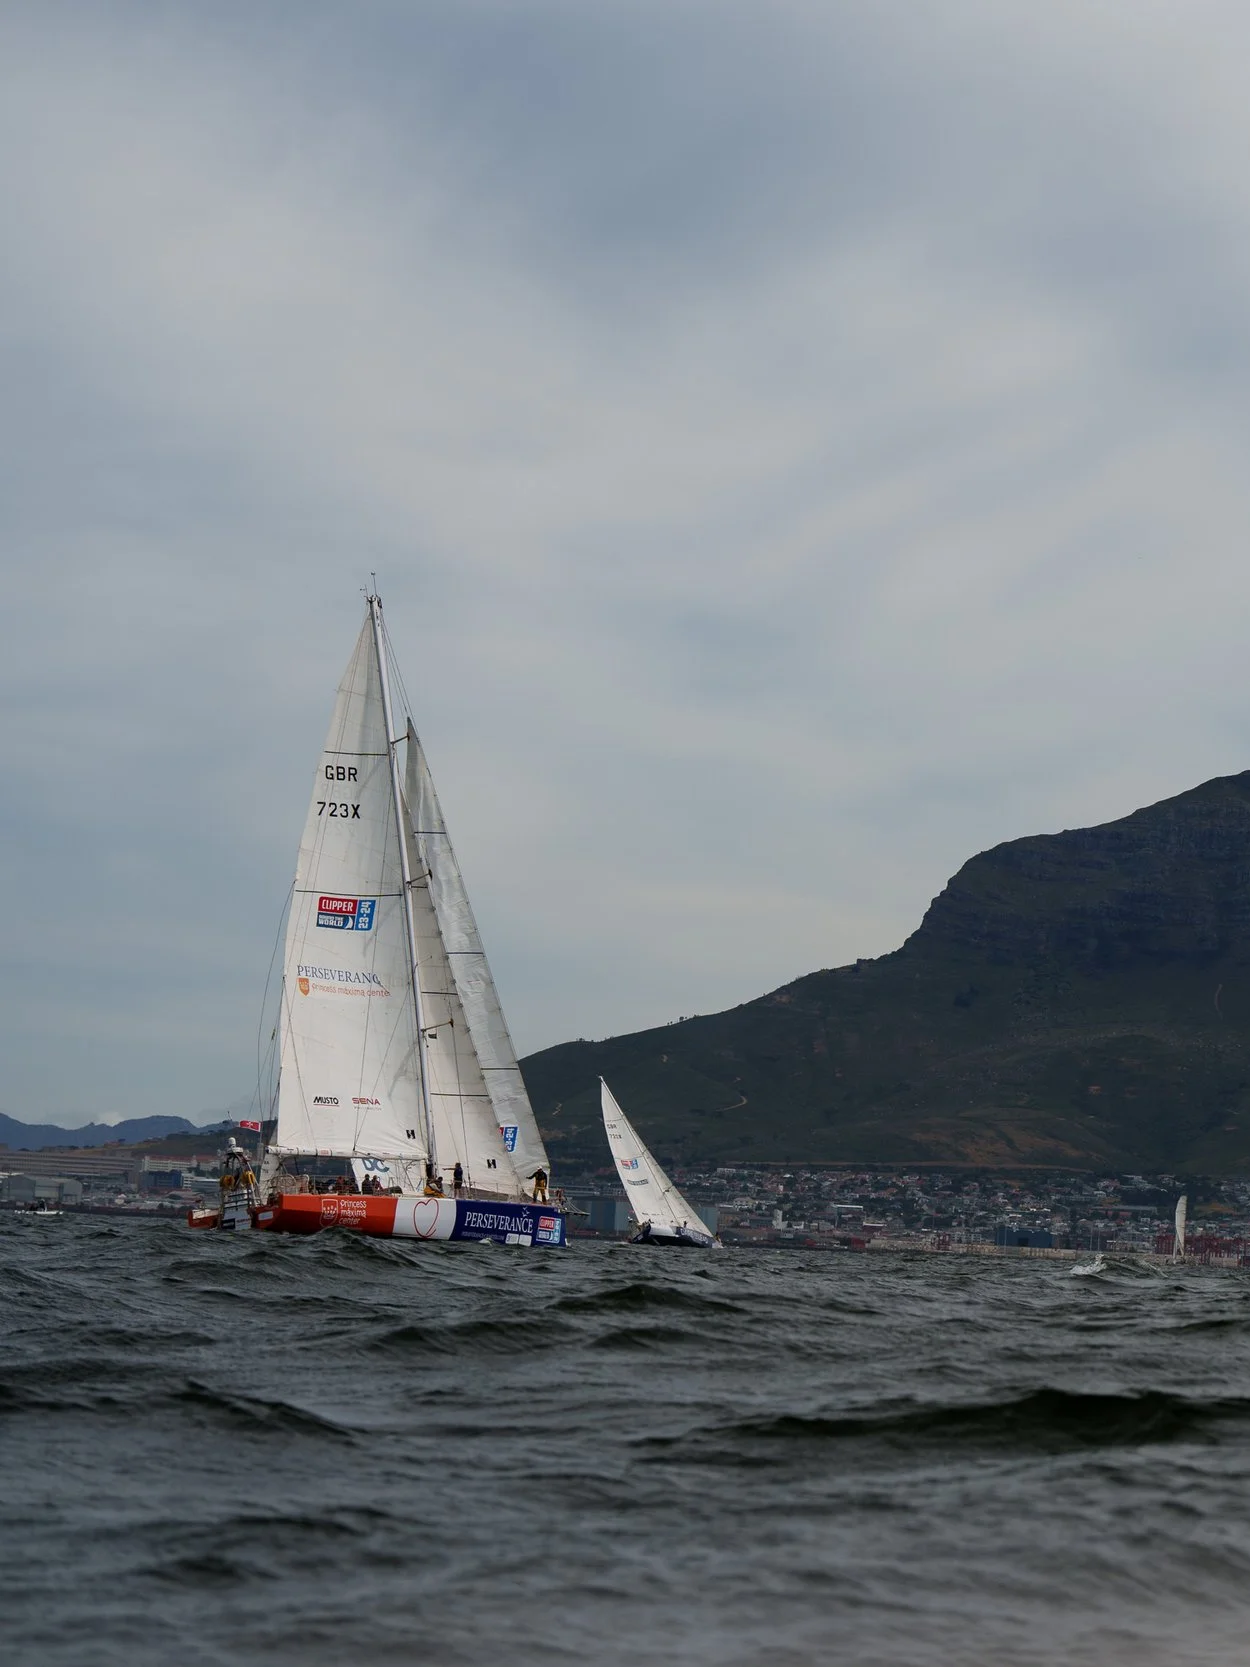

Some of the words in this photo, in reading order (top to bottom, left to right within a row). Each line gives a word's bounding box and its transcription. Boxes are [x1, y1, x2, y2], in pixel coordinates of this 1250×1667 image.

[325, 765, 358, 782] GBR
[317, 801, 361, 820] 723X
[321, 899, 353, 912] CLIPPER
[313, 1096, 339, 1105] MUSTO
[352, 1097, 381, 1106] SENA
[464, 1211, 534, 1234] PERSEVERANCE
